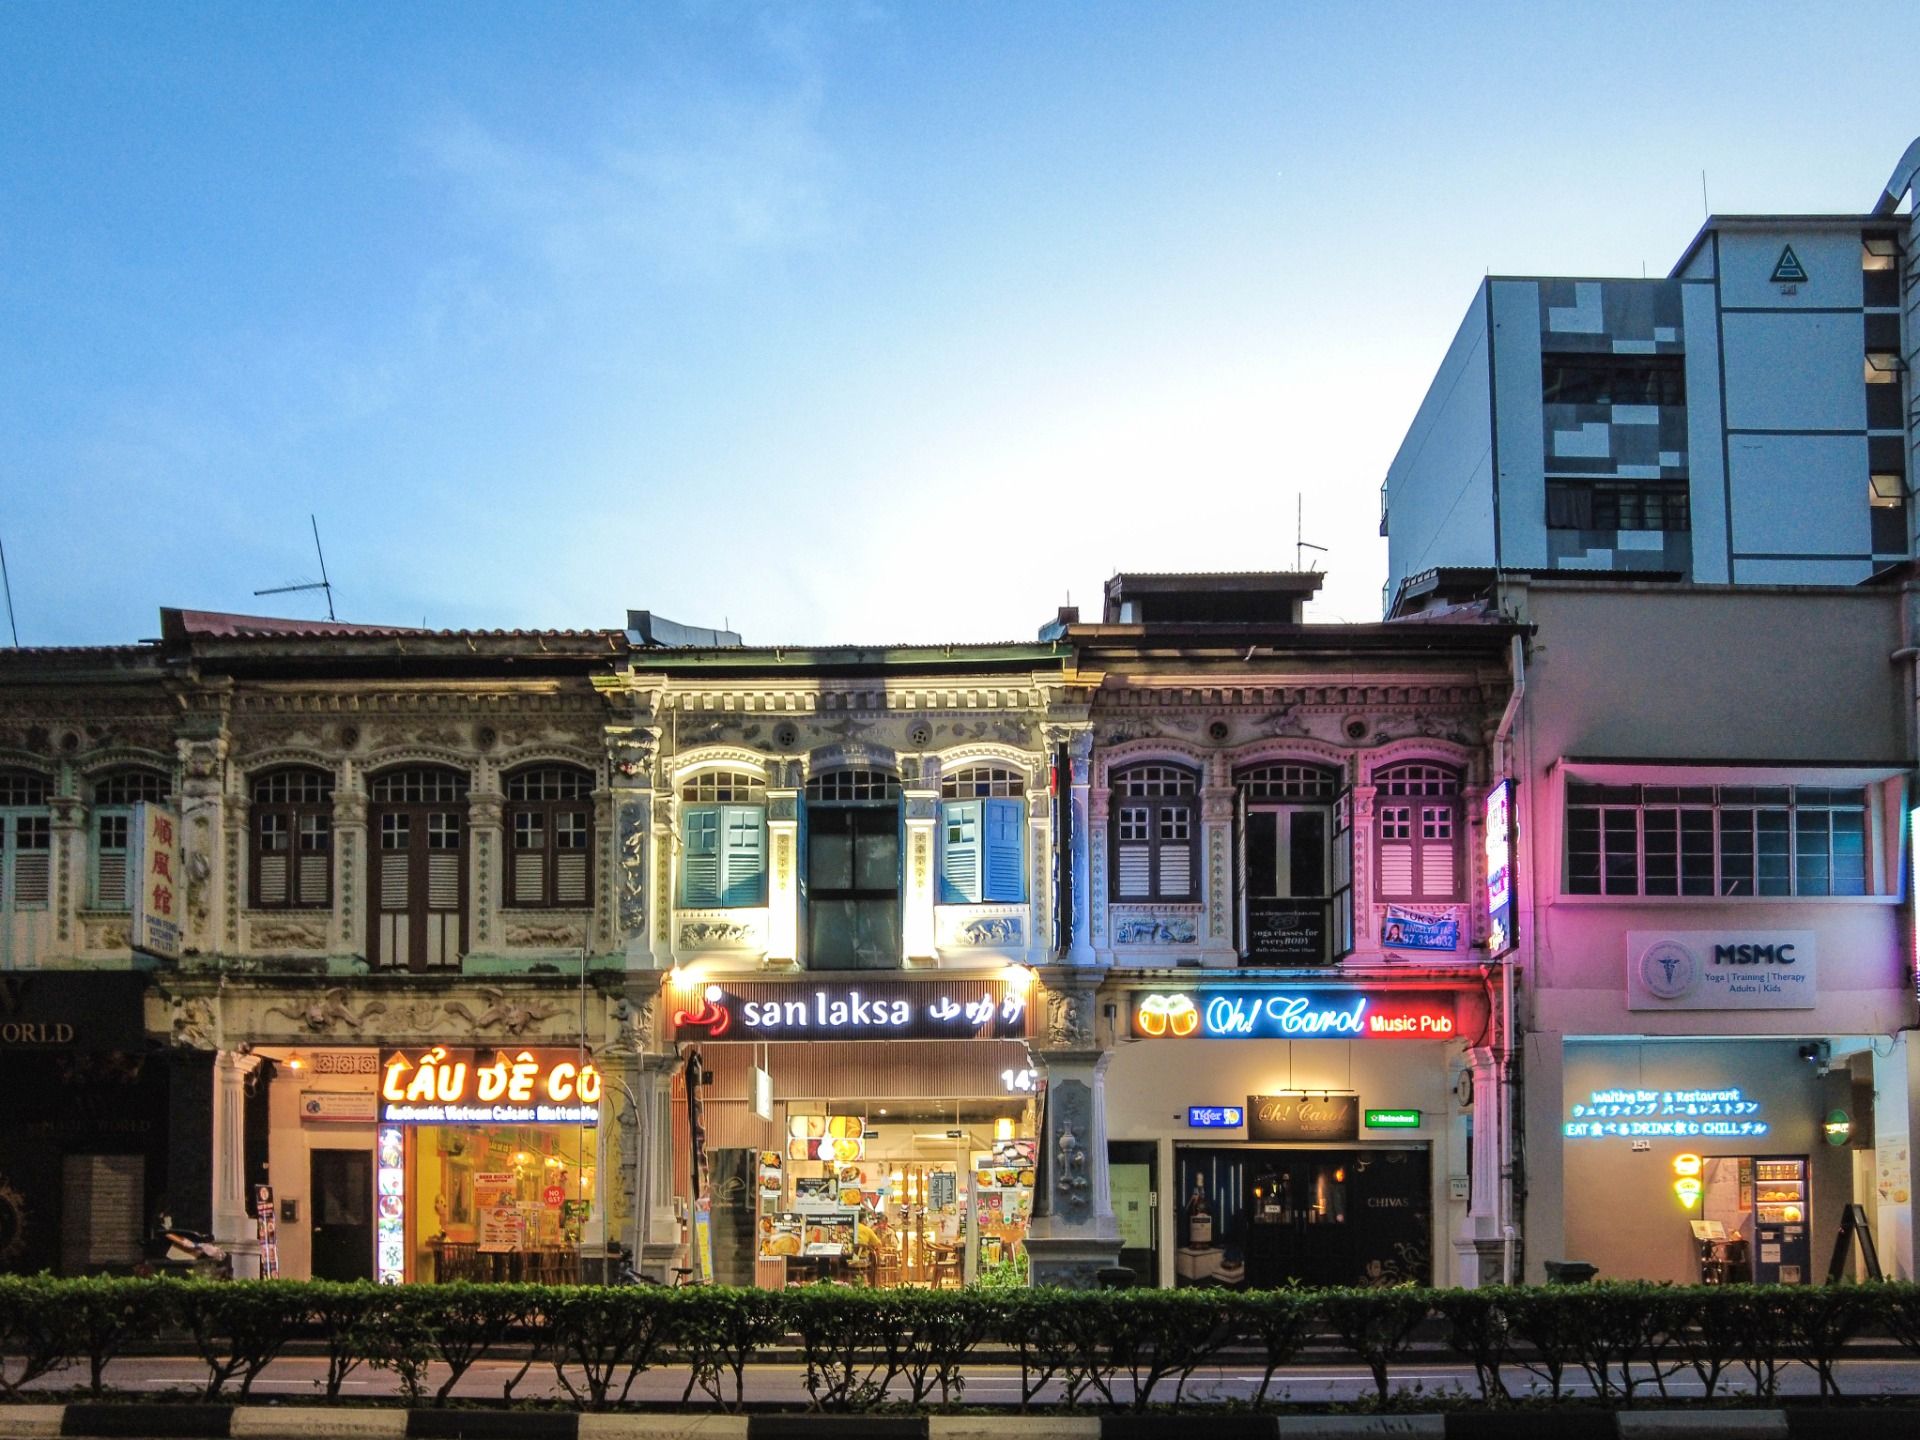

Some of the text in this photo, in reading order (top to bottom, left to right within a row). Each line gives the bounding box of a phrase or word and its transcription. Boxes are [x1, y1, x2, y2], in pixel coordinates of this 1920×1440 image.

[152, 815, 172, 915] 順風館
[1714, 944, 1796, 965] MSMC
[1705, 973, 1806, 983] Yoga Training Therapy
[1729, 984, 1781, 993] Adults Kids
[744, 992, 909, 1027] san laksa
[1206, 996, 1367, 1034] Oh! Carol
[1370, 1014, 1452, 1032] Music Pub
[0, 1023, 74, 1042] ORLD
[1592, 1089, 1635, 1104] Waiting
[1636, 1090, 1659, 1102] Bar
[1676, 1089, 1740, 1102] Restaurant
[385, 1104, 445, 1121] Authentic
[445, 1105, 492, 1121] Vietnam
[493, 1105, 536, 1121] Cuisine
[1192, 1109, 1221, 1125] Tiger
[1258, 1103, 1348, 1122] Oh! Carol
[1567, 1123, 1589, 1135] EAT
[1630, 1122, 1674, 1135] DRINK
[1703, 1122, 1740, 1135] CHILL
[1632, 1139, 1650, 1150] 151
[548, 1189, 560, 1197] NO
[1367, 1197, 1409, 1208] CHIVAS
